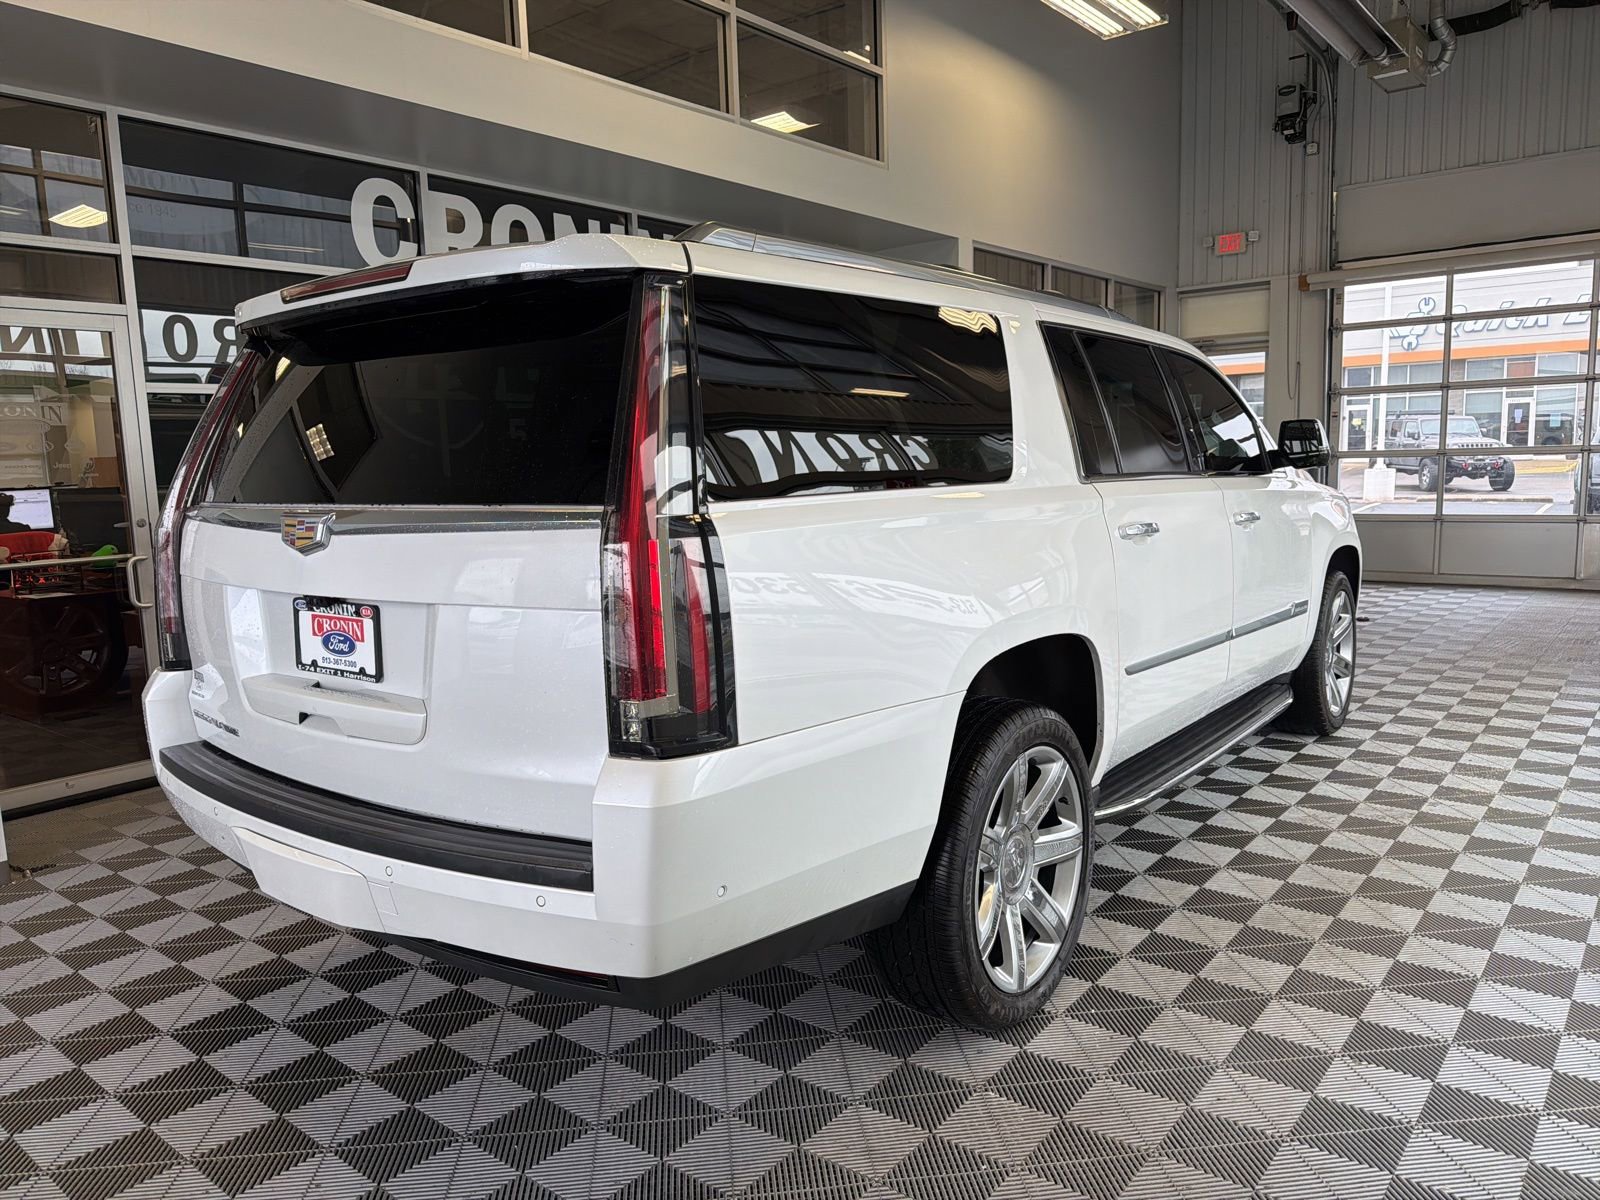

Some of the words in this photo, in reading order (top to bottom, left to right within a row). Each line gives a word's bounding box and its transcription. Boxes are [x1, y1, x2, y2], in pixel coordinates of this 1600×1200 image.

[351, 178, 673, 268] CRO
[1219, 235, 1242, 253] EXIT
[314, 617, 362, 641] CRONIN
[328, 634, 350, 652] Ford
[321, 656, 358, 669] 513-367-5300
[316, 667, 335, 676] EXIT
[344, 671, 376, 683] Harrison
